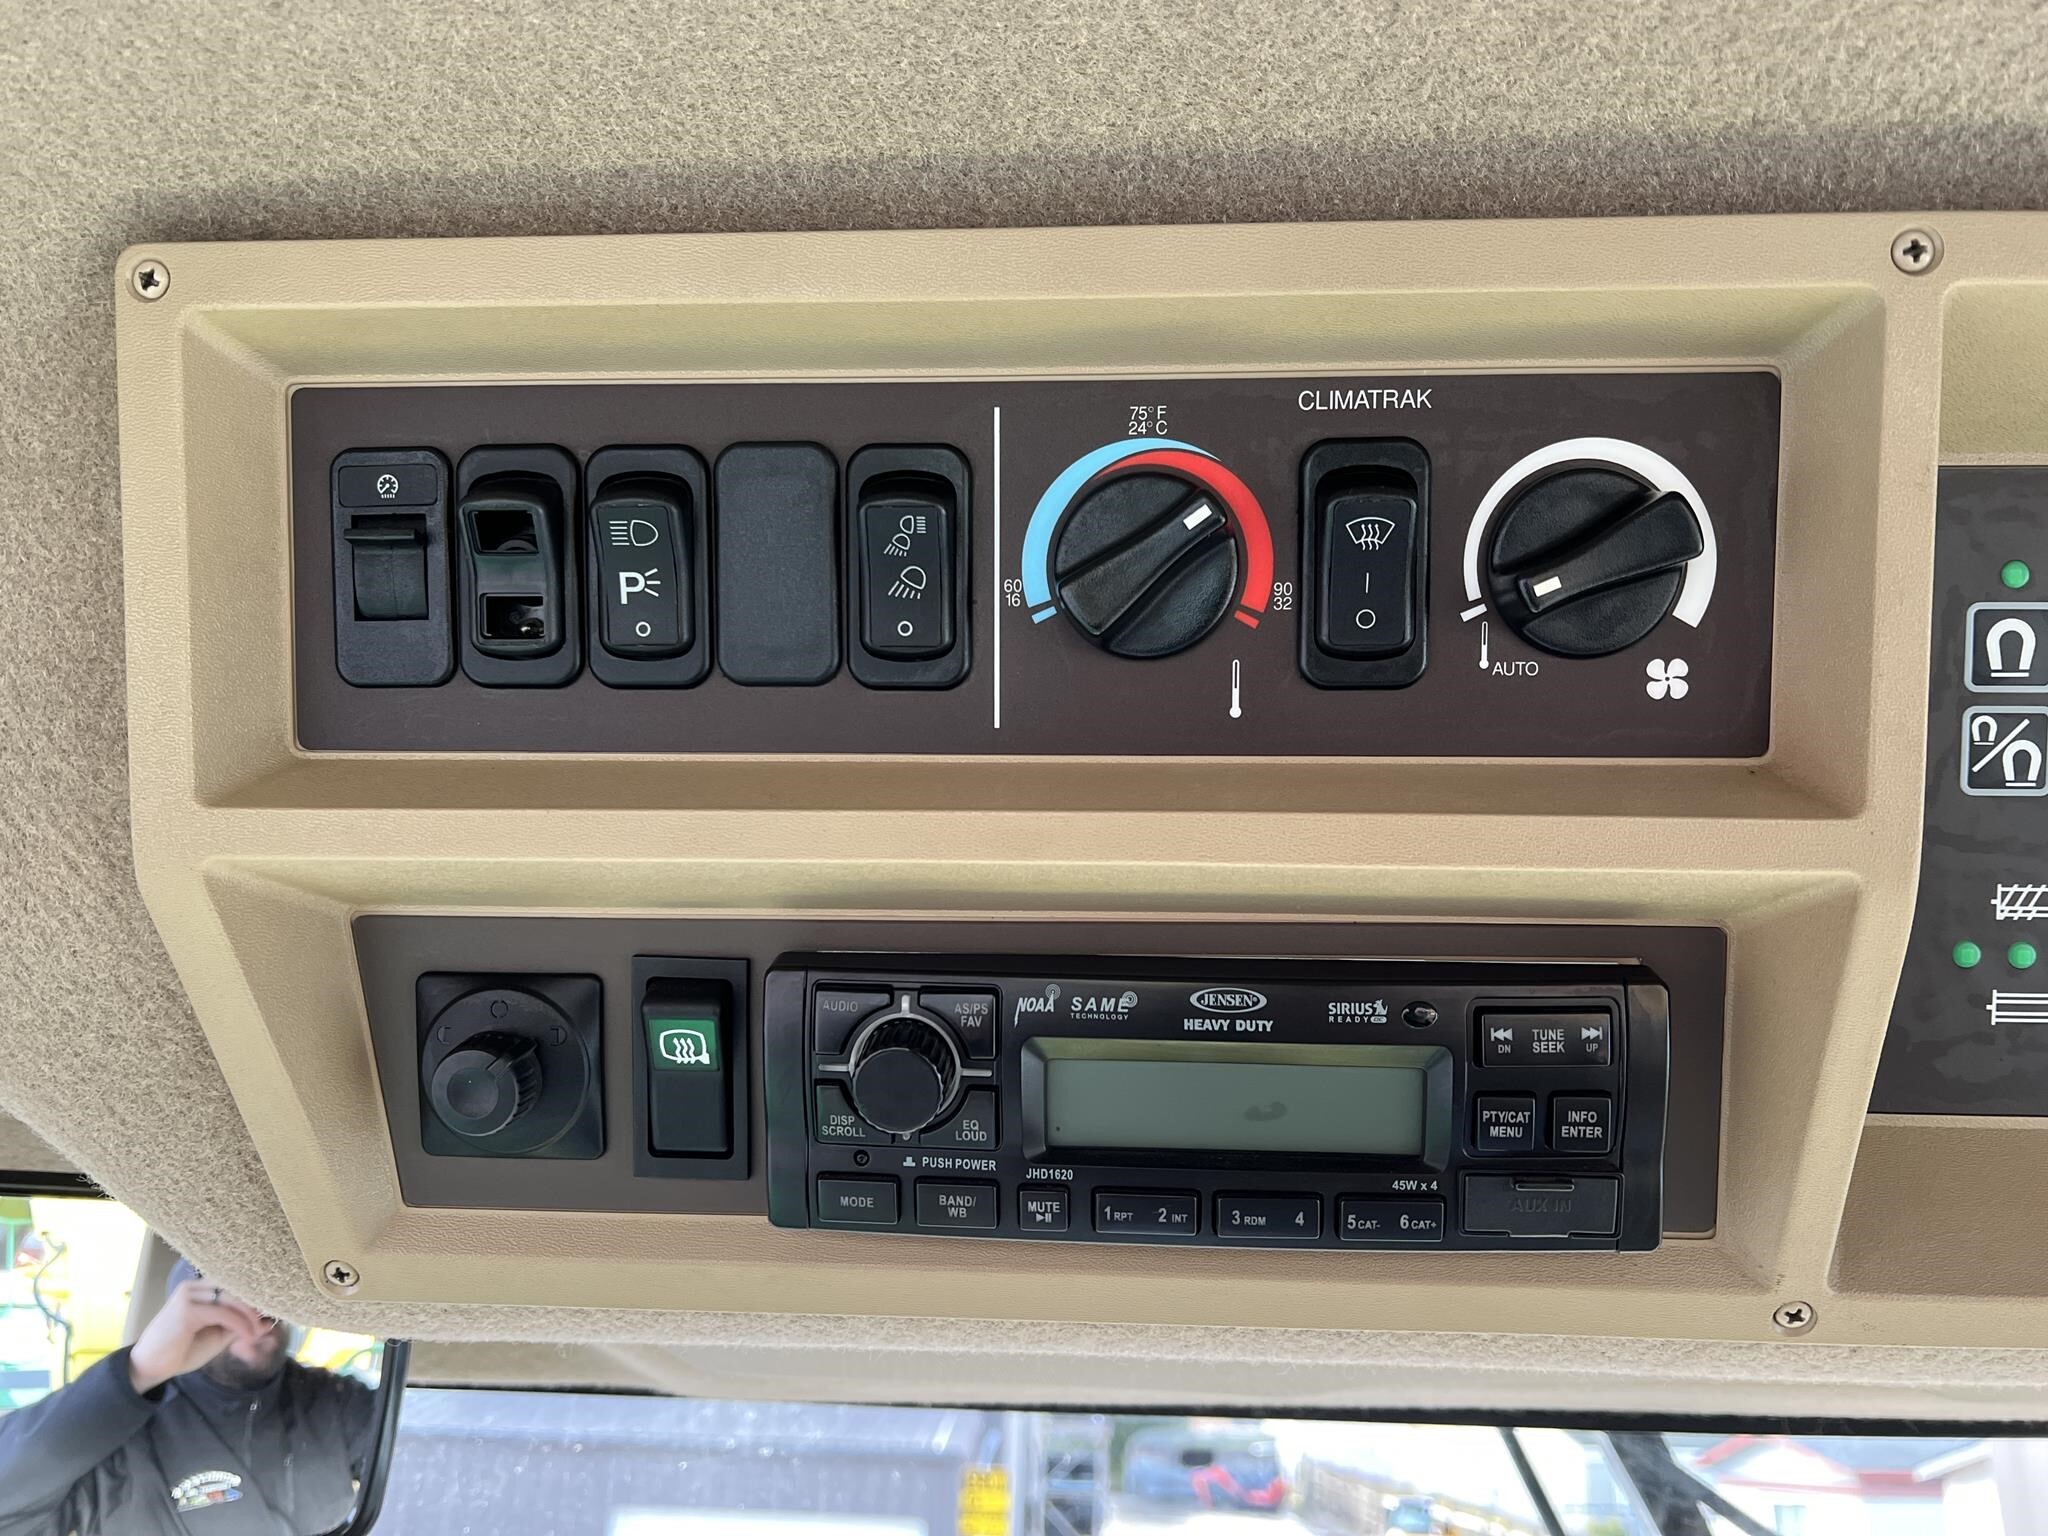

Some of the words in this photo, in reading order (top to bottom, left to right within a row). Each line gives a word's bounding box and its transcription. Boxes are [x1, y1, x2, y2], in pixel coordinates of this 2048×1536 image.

[1298, 388, 1432, 412] CLIMATRAK
[1158, 406, 1167, 421] F
[1155, 421, 1168, 436] C
[1003, 579, 1022, 594] 60
[1274, 582, 1293, 596] 90
[1005, 593, 1021, 608] 16
[1273, 596, 1292, 611] 32
[1492, 662, 1539, 677] AUTO
[822, 1001, 858, 1012] AUDIO
[954, 1003, 988, 1015] AS/PS
[1014, 997, 1055, 1023] NOAA
[1071, 997, 1129, 1013] SAME
[1328, 1002, 1373, 1015] SIRIUS
[960, 1015, 982, 1028] FAV
[1183, 1019, 1229, 1031] HEAVY
[1236, 1020, 1273, 1033] DUTY
[1532, 1029, 1564, 1041] TUNE
[1498, 1044, 1511, 1054] DN
[1532, 1041, 1565, 1053] SEEK
[1586, 1043, 1599, 1052] UP
[829, 1115, 855, 1126] DISP
[1482, 1111, 1530, 1124] PTY/CAT
[1568, 1111, 1597, 1123] INFO
[822, 1125, 866, 1137] SCROLL
[963, 1120, 979, 1131] EQ
[1489, 1126, 1523, 1138] MENU
[955, 1130, 987, 1142] LOUD
[1561, 1126, 1602, 1139] ENTER
[922, 1156, 953, 1169] PUSH
[955, 1158, 996, 1171] POWER
[1026, 1168, 1074, 1181] JHD1620
[1392, 1180, 1418, 1191] 45W
[1421, 1182, 1428, 1191] x
[1430, 1181, 1438, 1191] 4
[840, 1196, 874, 1208] MODE
[938, 1195, 977, 1207] BAND/
[1028, 1201, 1060, 1213] MUTE
[1511, 1199, 1547, 1212] AUX
[948, 1206, 967, 1218] WB
[1104, 1206, 1111, 1221] 1
[1113, 1211, 1134, 1221] RPT
[1158, 1208, 1167, 1223] 2
[1171, 1213, 1187, 1223] INT
[1232, 1210, 1241, 1225] 3
[1244, 1214, 1266, 1226] RDM
[1295, 1212, 1305, 1226] 4
[1347, 1214, 1356, 1229] 5
[1357, 1219, 1380, 1229] CAT-
[1400, 1214, 1408, 1229] 6
[1411, 1219, 1437, 1229] CAT+
